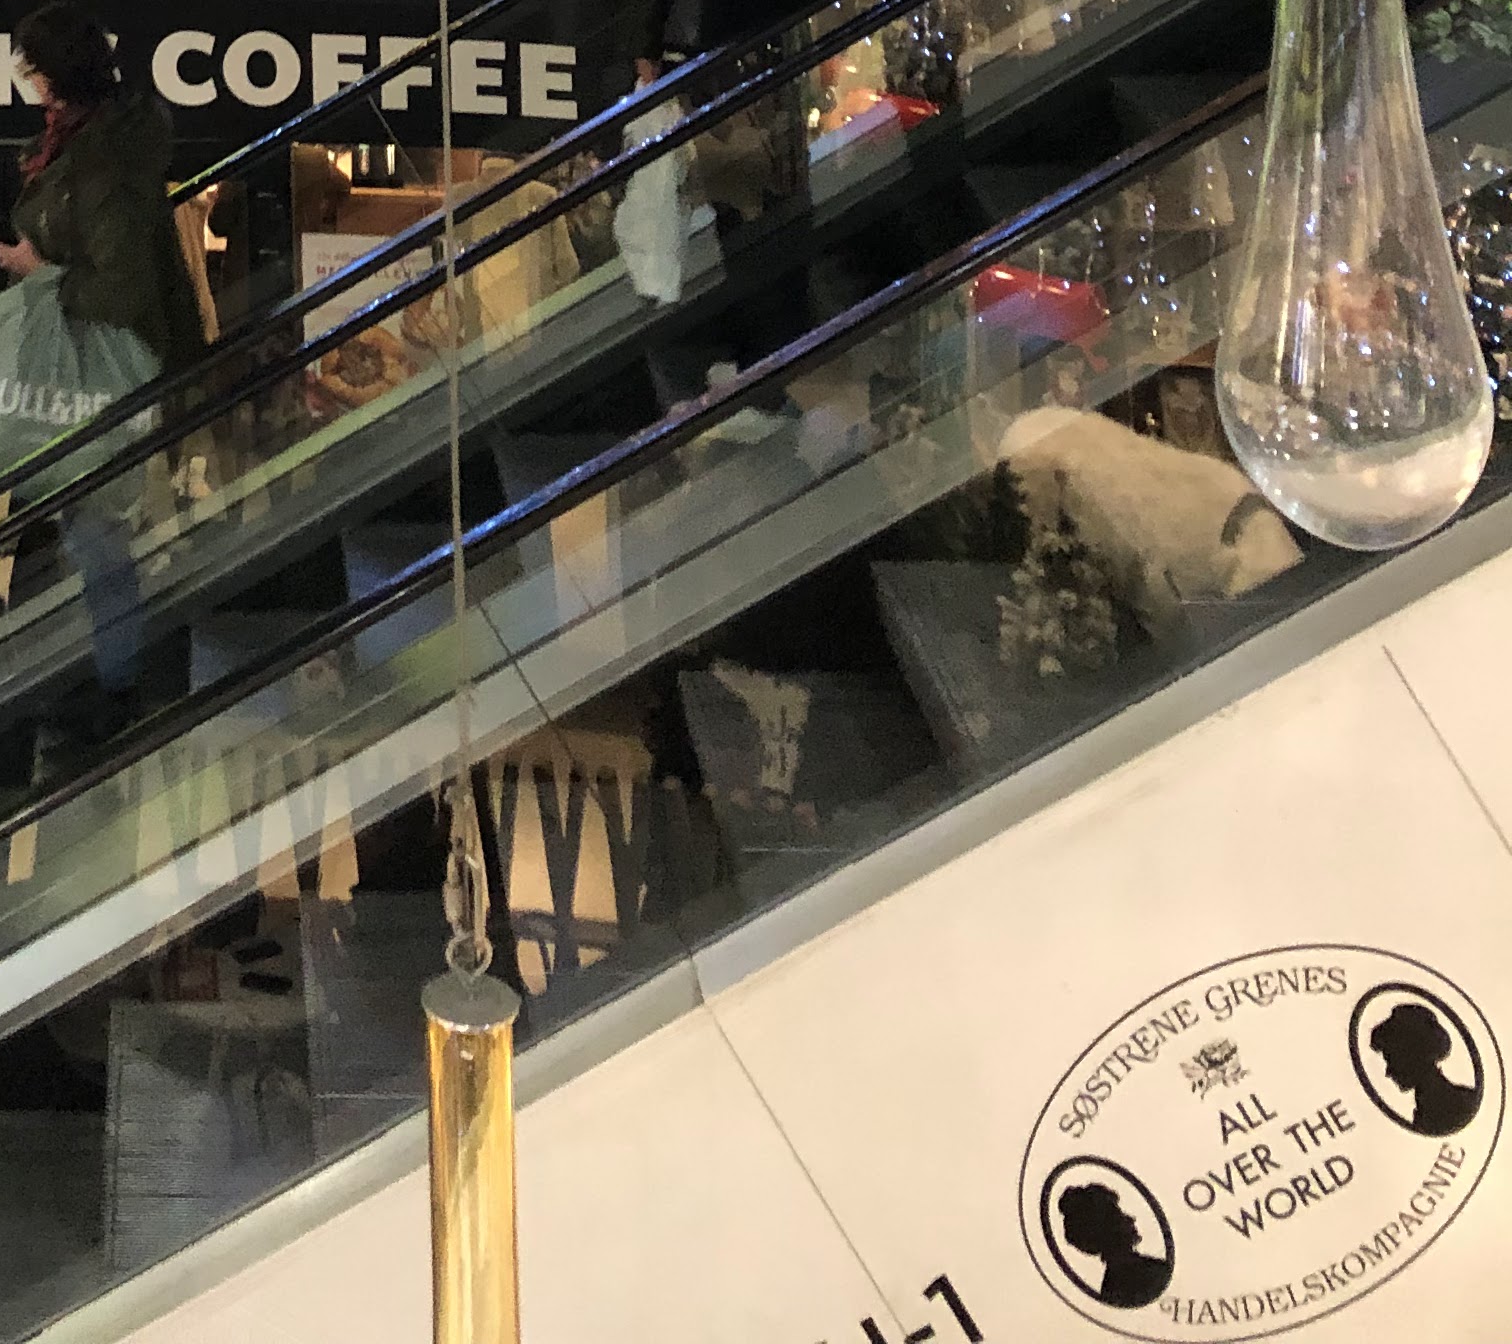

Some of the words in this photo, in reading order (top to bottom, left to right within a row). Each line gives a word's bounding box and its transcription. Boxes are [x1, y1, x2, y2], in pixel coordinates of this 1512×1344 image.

[152, 29, 578, 121] COFFEE
[1059, 999, 1199, 1139] SØSTRENE
[1205, 966, 1347, 1021] GRENES
[1183, 1143, 1280, 1212] OVER
[1284, 1098, 1355, 1154] THE
[1219, 1093, 1278, 1146] ALL
[1159, 1141, 1466, 1325] HANDELSKOMPAGNIE
[1224, 1154, 1354, 1240] WORLD
